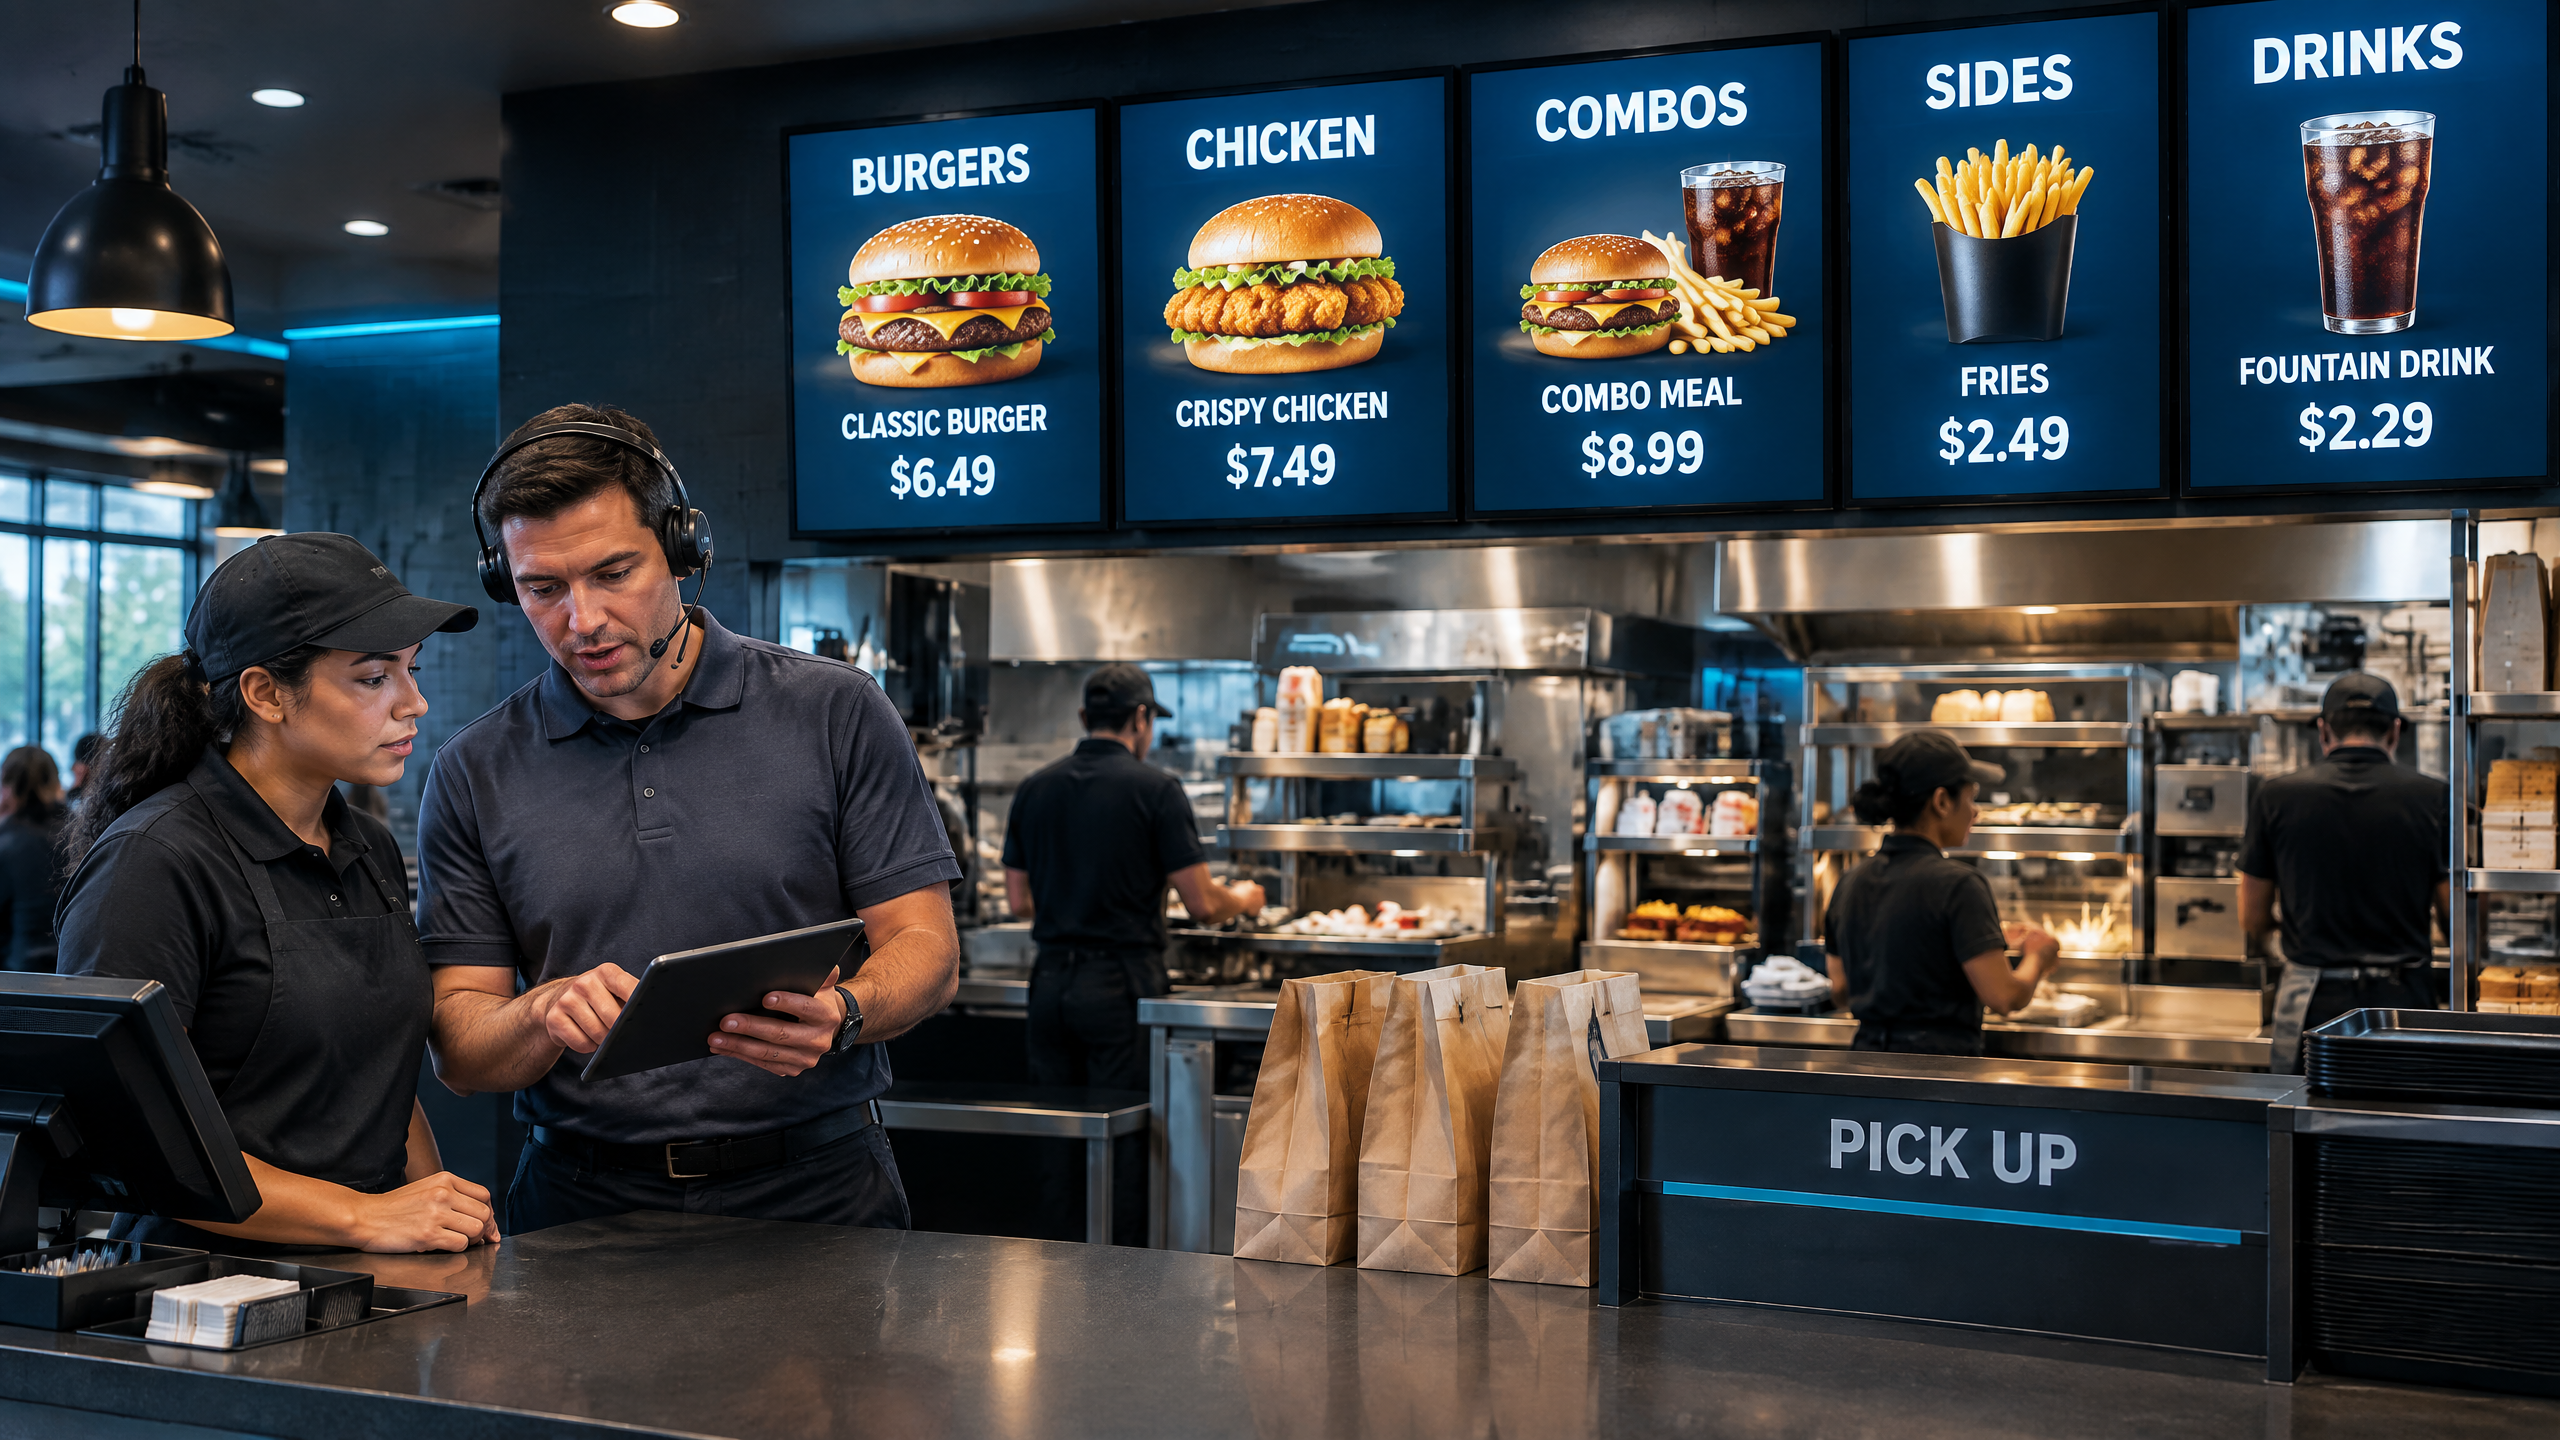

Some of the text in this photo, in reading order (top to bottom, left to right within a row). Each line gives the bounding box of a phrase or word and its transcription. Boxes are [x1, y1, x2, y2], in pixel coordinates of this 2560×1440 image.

[2253, 21, 2464, 85] DRINKS
[1925, 53, 2073, 110] SIDES
[1535, 81, 1748, 142] COMBOS
[1186, 114, 1375, 170] CHICKEN
[852, 143, 1030, 196] BURGERS
[1961, 363, 2049, 397] FRIES
[2240, 345, 2495, 386] FOUNTAIN DRINK
[1175, 391, 1388, 428] CRISPY CHICKEN
[1541, 376, 1743, 414] COMBO MEAL
[841, 404, 1048, 440] CLASSIC BURGER
[1939, 415, 2070, 466] $2.49
[2298, 401, 2433, 453] $2.29
[890, 454, 996, 500] $6.49
[1226, 442, 1336, 490] $7.49
[1581, 430, 1704, 479] $8.99
[1830, 1118, 2077, 1187] PICK UP
